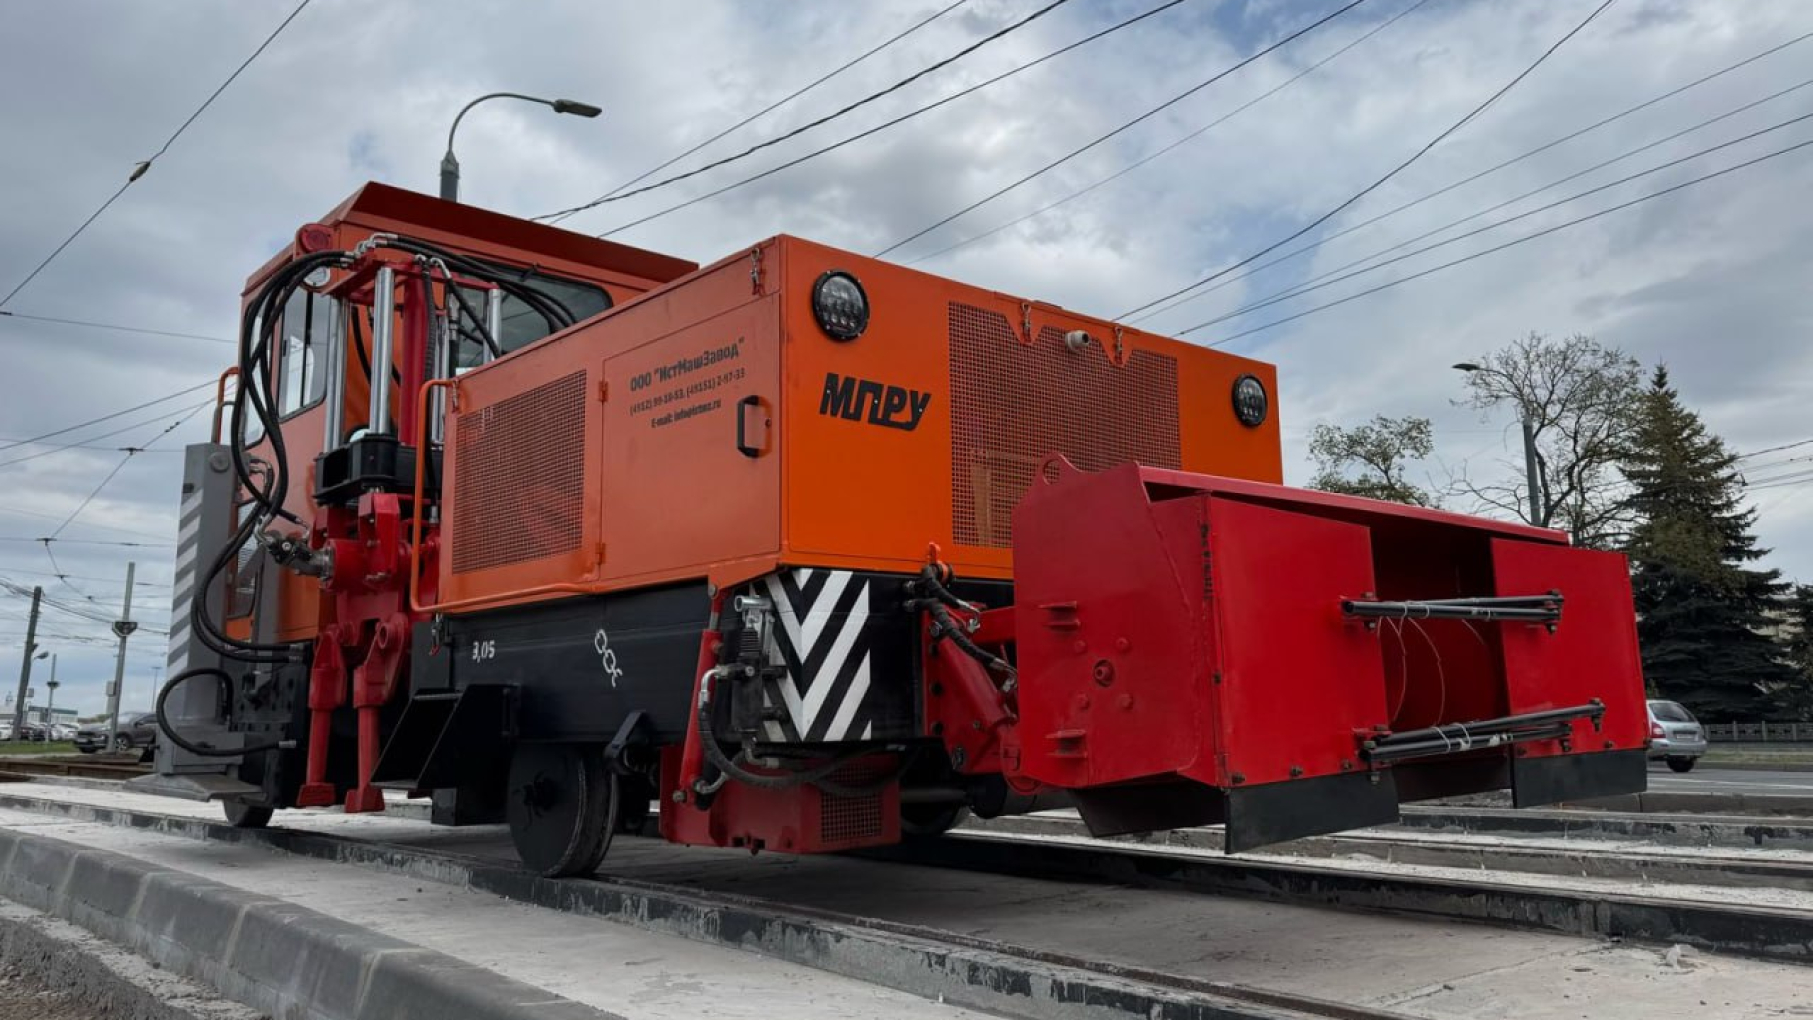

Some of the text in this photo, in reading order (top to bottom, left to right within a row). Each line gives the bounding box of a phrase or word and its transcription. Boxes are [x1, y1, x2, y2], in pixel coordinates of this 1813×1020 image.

[630, 372, 652, 392] ООО
[819, 372, 932, 431] МПРУ
[472, 640, 495, 663] 3,05
